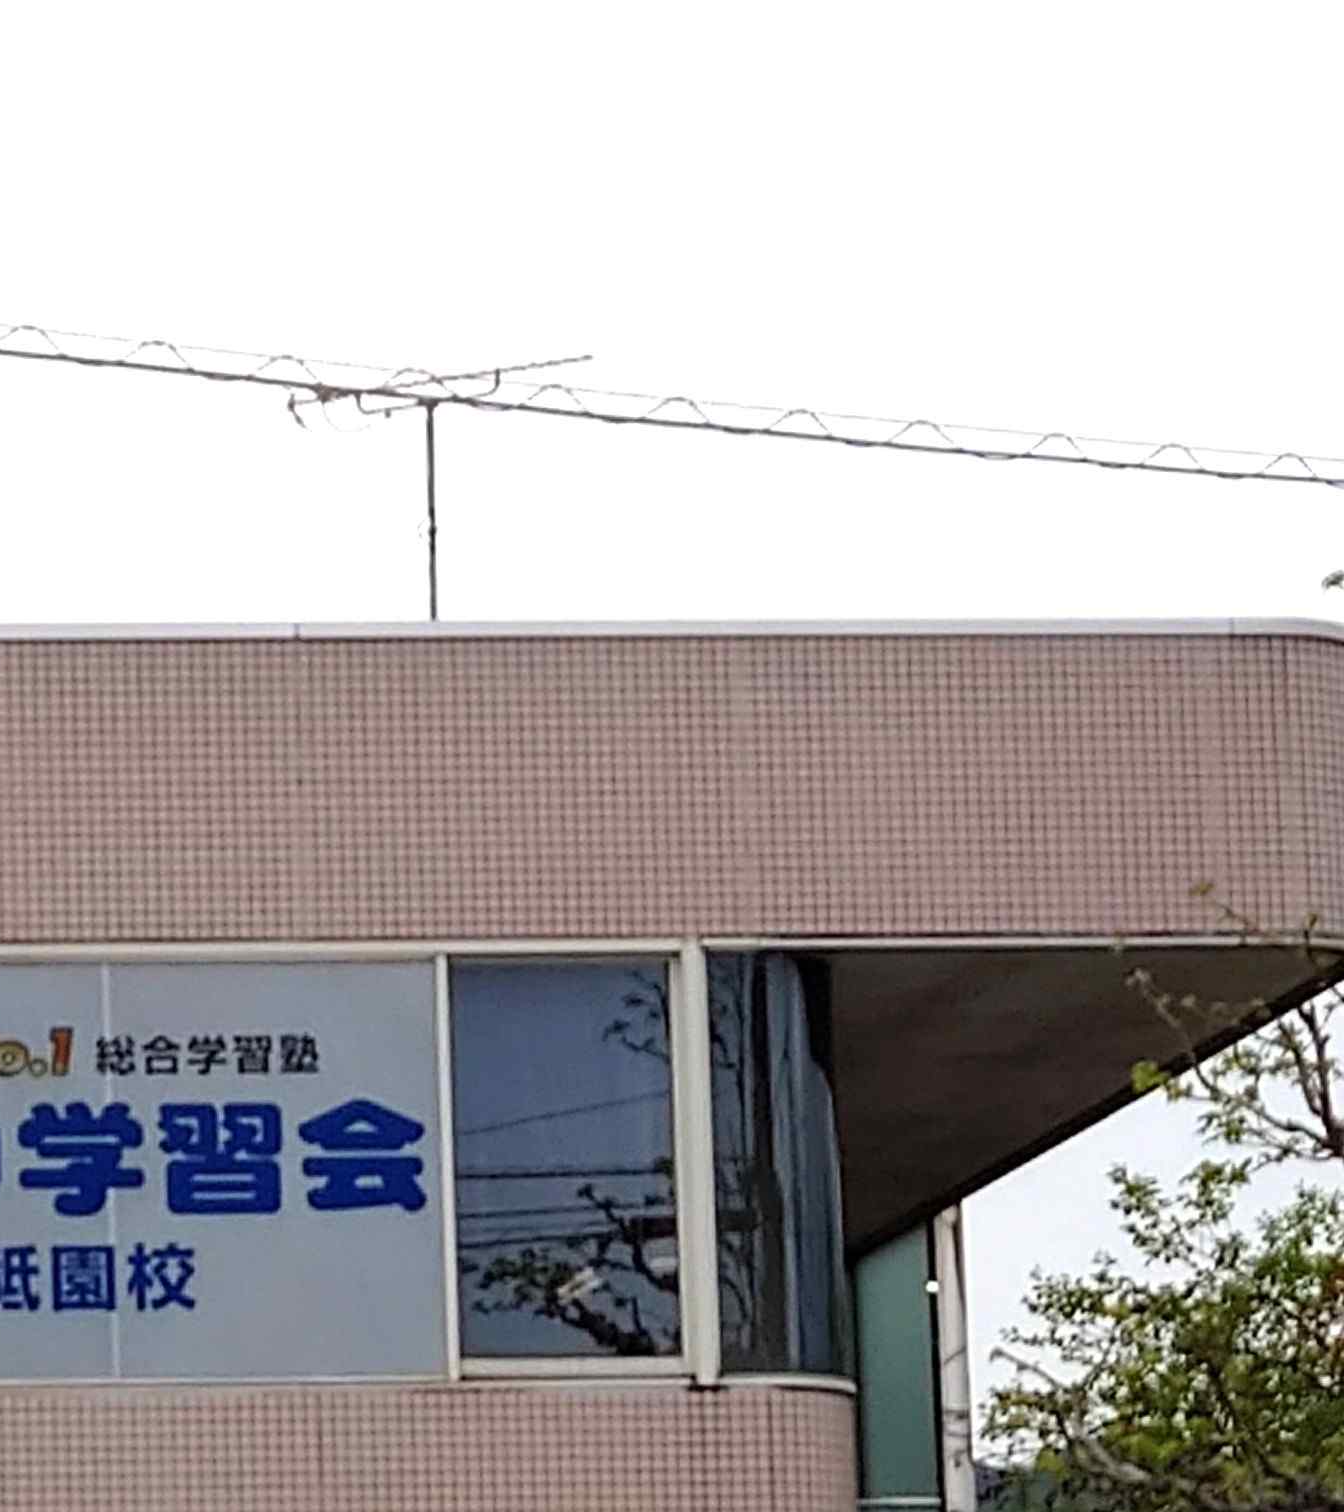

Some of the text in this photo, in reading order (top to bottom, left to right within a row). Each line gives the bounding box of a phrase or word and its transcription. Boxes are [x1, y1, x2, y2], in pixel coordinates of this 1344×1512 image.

[95, 1033, 320, 1076] 総合学習塾
